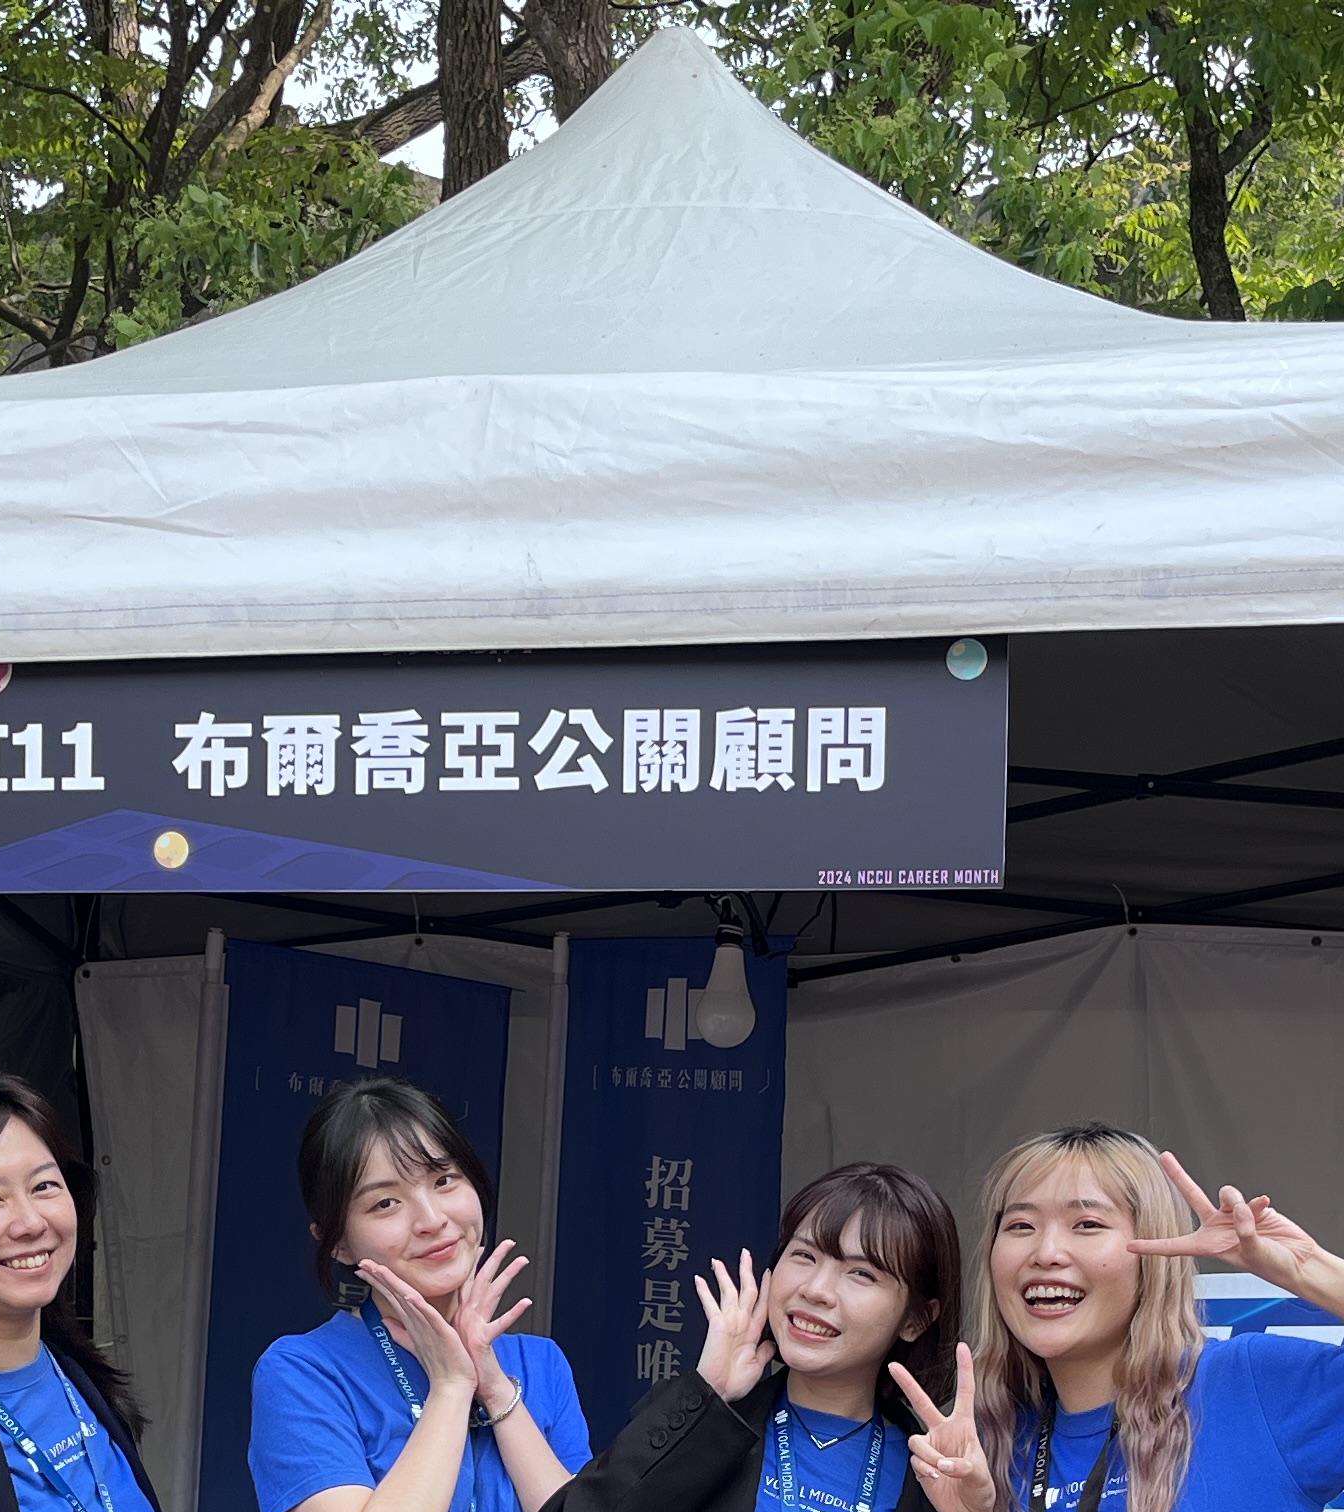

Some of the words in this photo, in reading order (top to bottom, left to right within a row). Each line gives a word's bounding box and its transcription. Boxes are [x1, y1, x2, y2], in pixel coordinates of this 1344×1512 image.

[171, 706, 887, 797] 布爾喬亞公關顧問
[818, 870, 852, 885] 2024
[857, 870, 893, 885] NCCU
[898, 869, 949, 885] CAREER
[954, 869, 999, 884] MONTH
[375, 1330, 400, 1367] MIDDLE
[394, 1366, 416, 1401] VOCAL
[777, 1428, 791, 1461] VOCAL
[868, 1429, 884, 1467] MIDDLE
[780, 1462, 795, 1503] MIDDLE
[861, 1466, 877, 1498] VOCAL
[808, 1488, 854, 1512] MIDDLE
